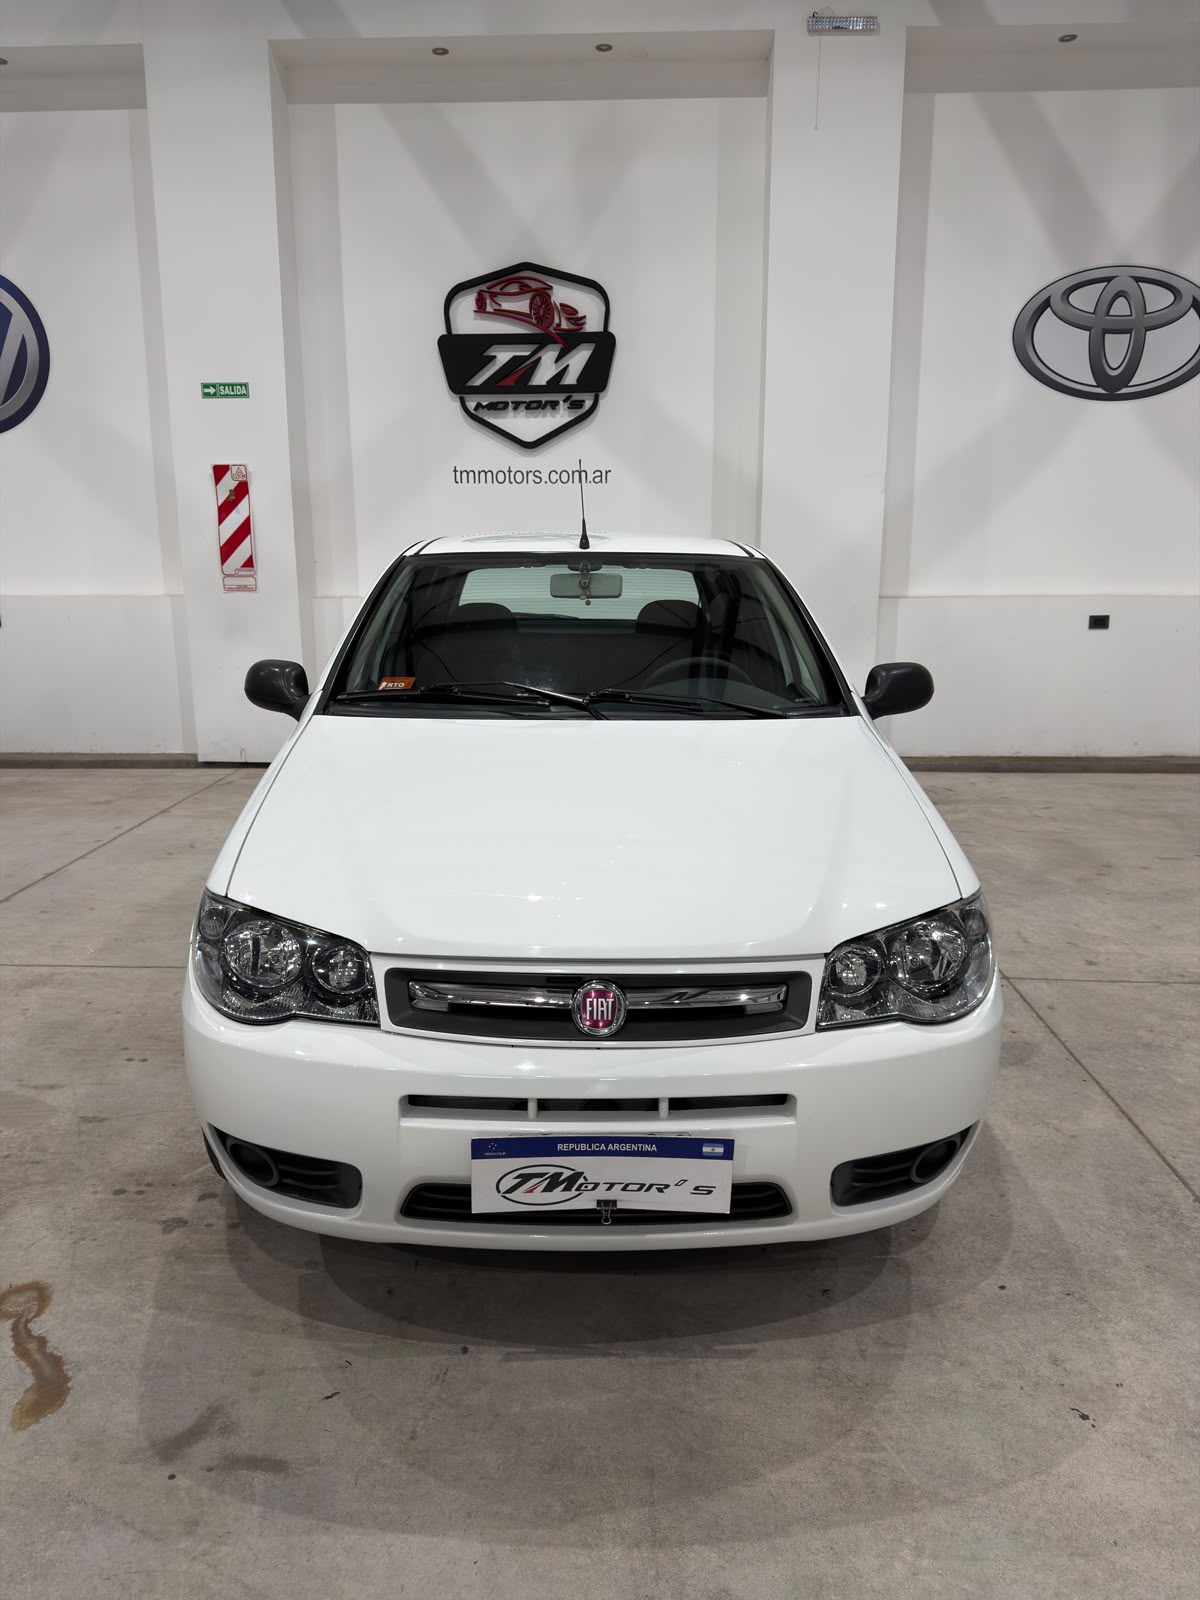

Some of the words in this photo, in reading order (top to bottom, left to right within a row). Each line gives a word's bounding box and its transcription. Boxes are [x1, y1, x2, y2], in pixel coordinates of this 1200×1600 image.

[219, 385, 248, 396] SALIDA
[473, 394, 585, 412] MOTOR'S
[453, 465, 612, 484] tmmotors.com.ar
[586, 998, 614, 1020] FIAT
[557, 1143, 606, 1152] REPUBLICA
[608, 1143, 657, 1152] ARGENTINA
